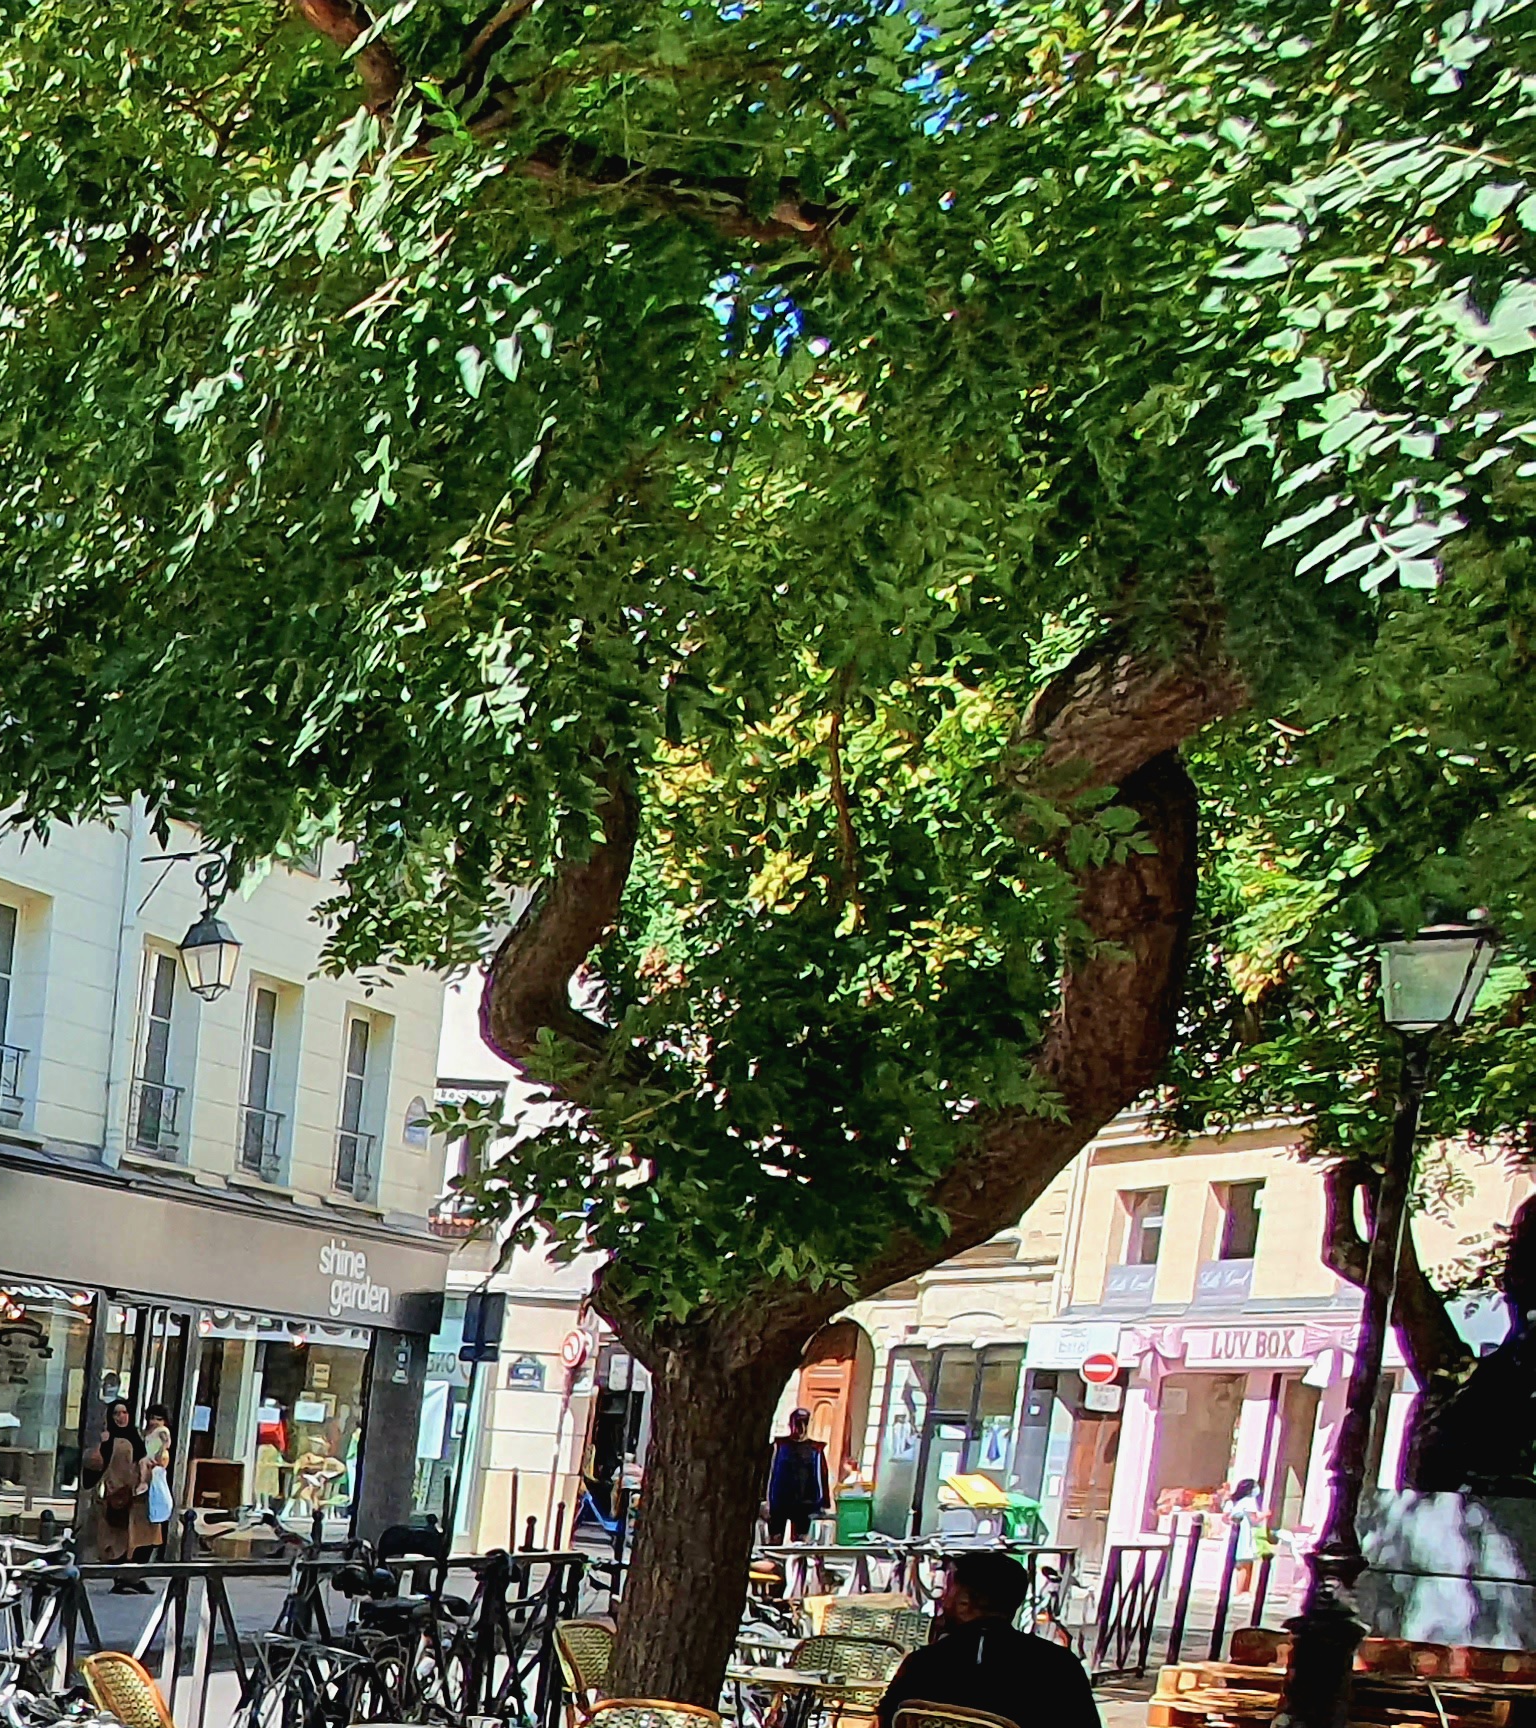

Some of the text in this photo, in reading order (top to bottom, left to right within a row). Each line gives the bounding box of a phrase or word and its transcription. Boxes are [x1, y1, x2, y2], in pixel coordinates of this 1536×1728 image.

[319, 1239, 366, 1279] shine
[329, 1275, 390, 1317] garden
[1212, 1329, 1296, 1360] LUV BOX
